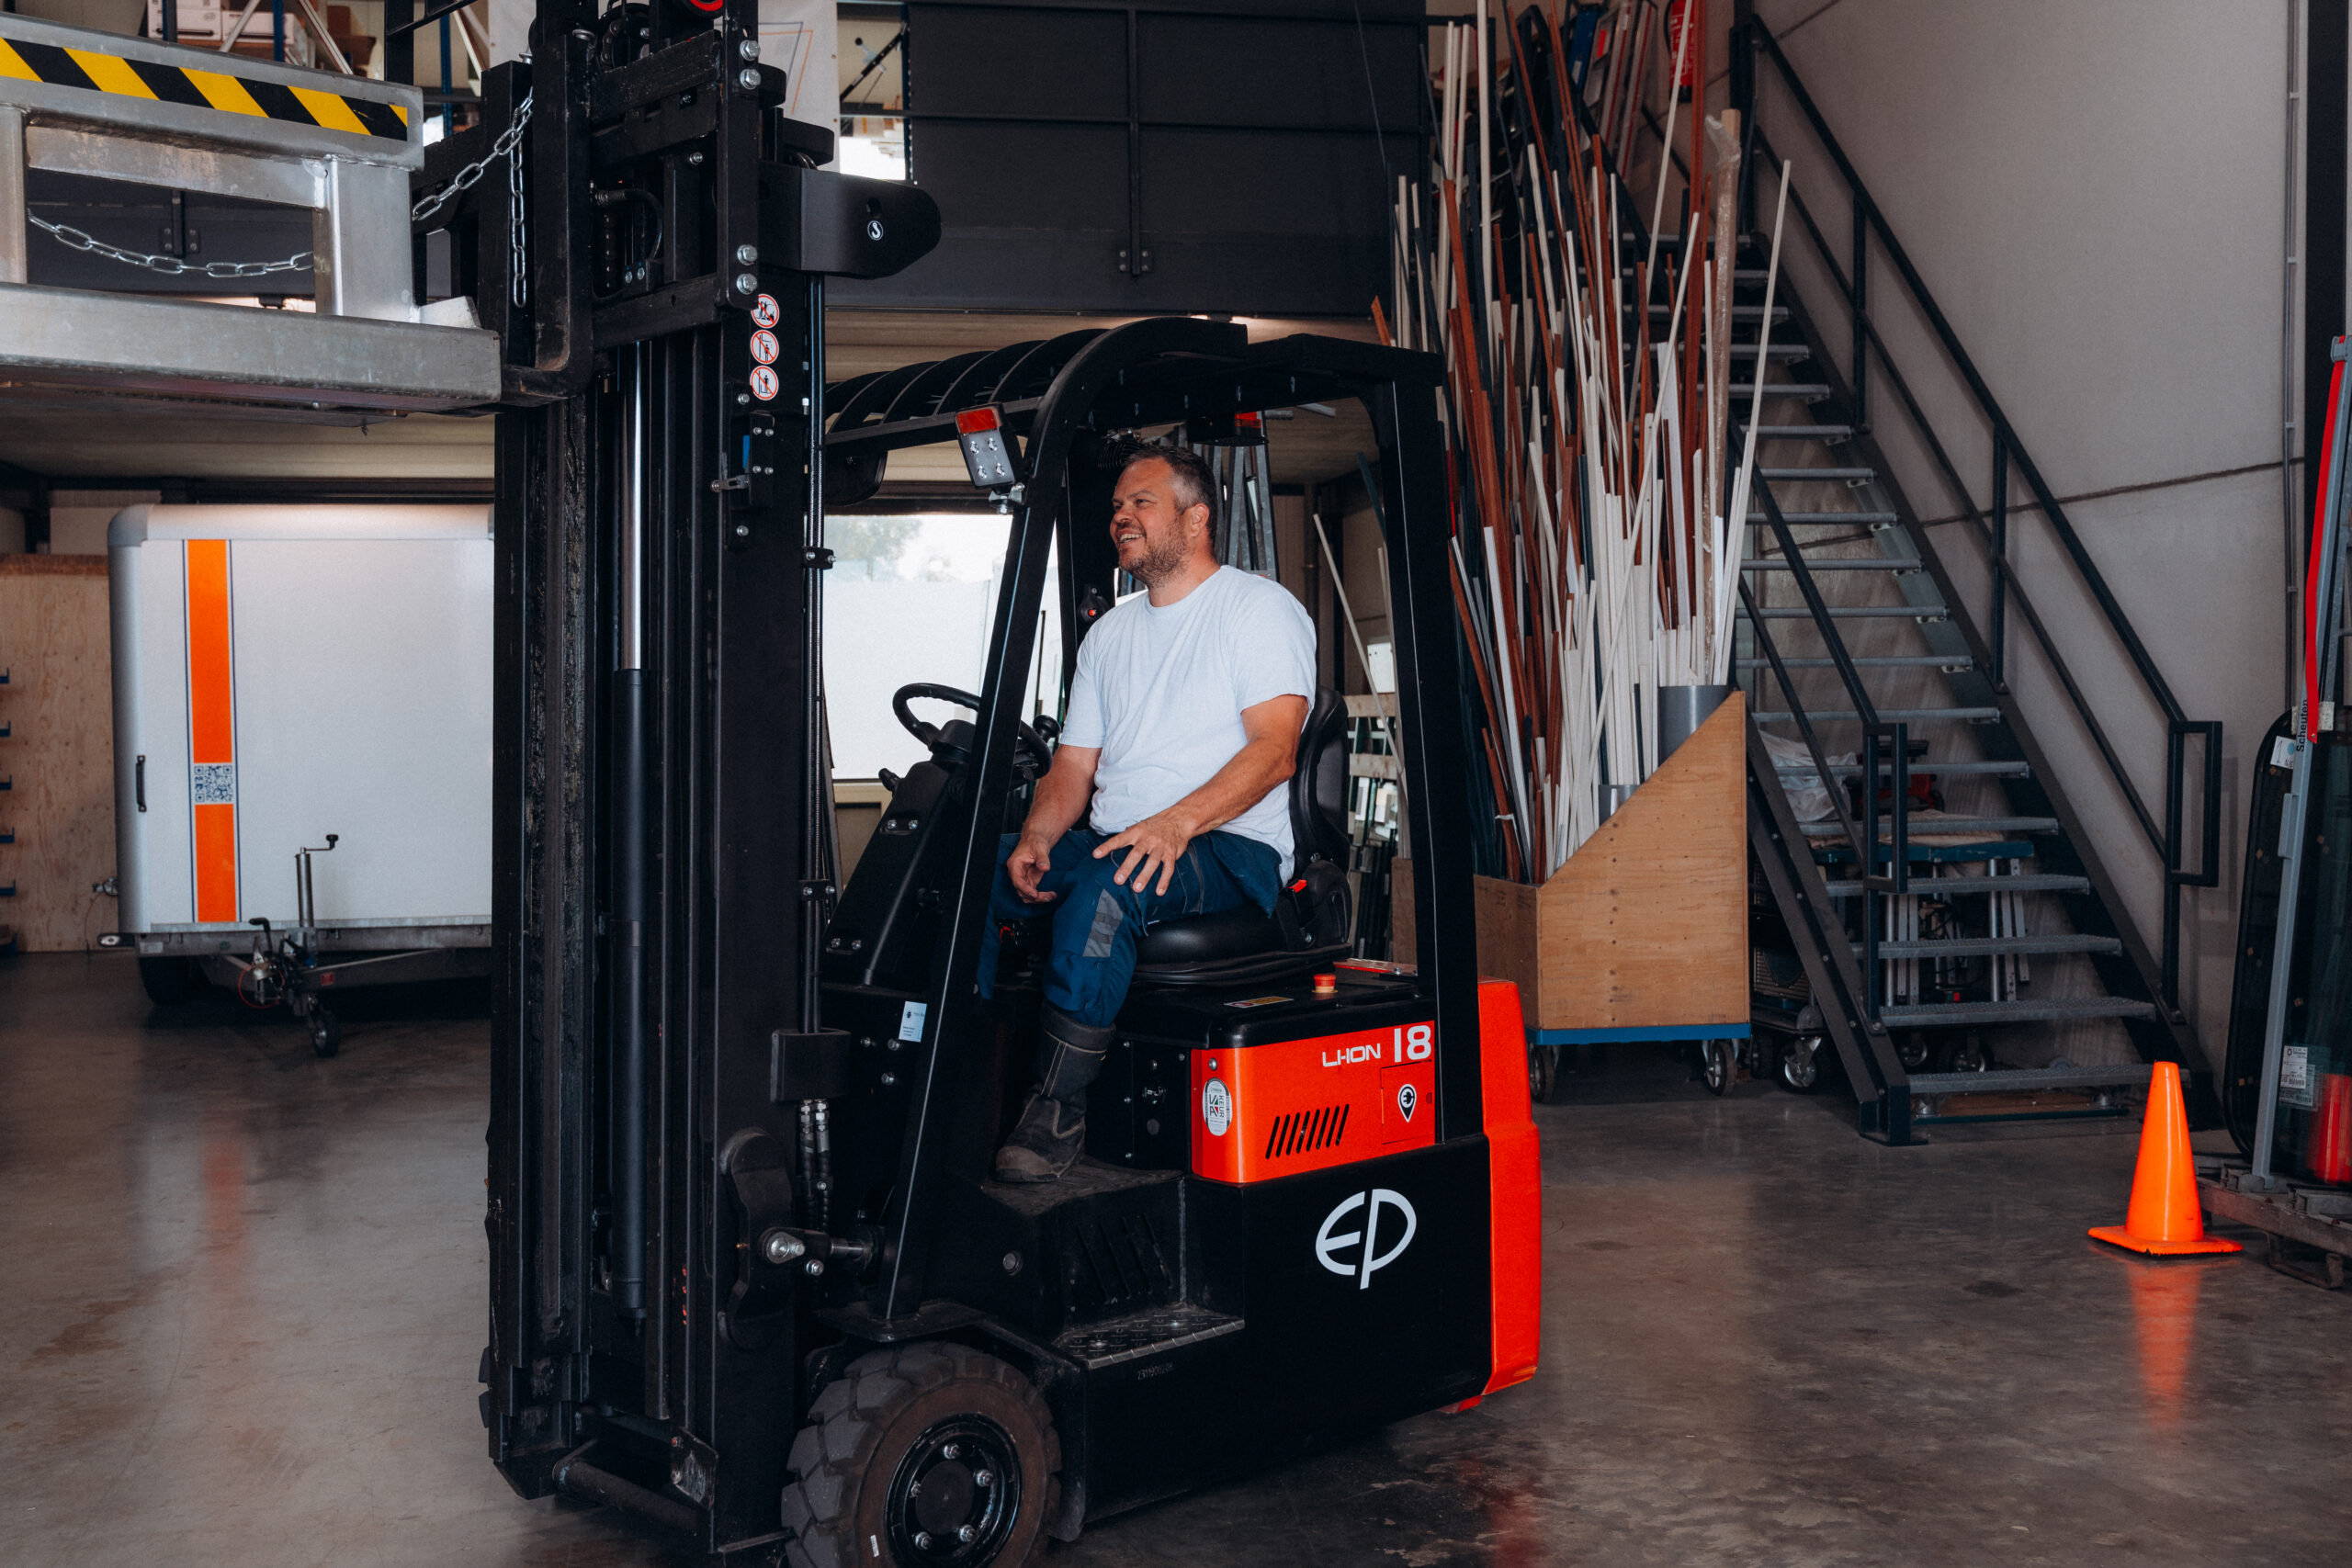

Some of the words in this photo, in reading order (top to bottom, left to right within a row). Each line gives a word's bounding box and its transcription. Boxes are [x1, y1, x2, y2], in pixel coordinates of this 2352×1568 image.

[2296, 699, 2308, 752] Scheuten
[1394, 1024, 1431, 1063] 18
[1316, 1189, 1417, 1289] EP
